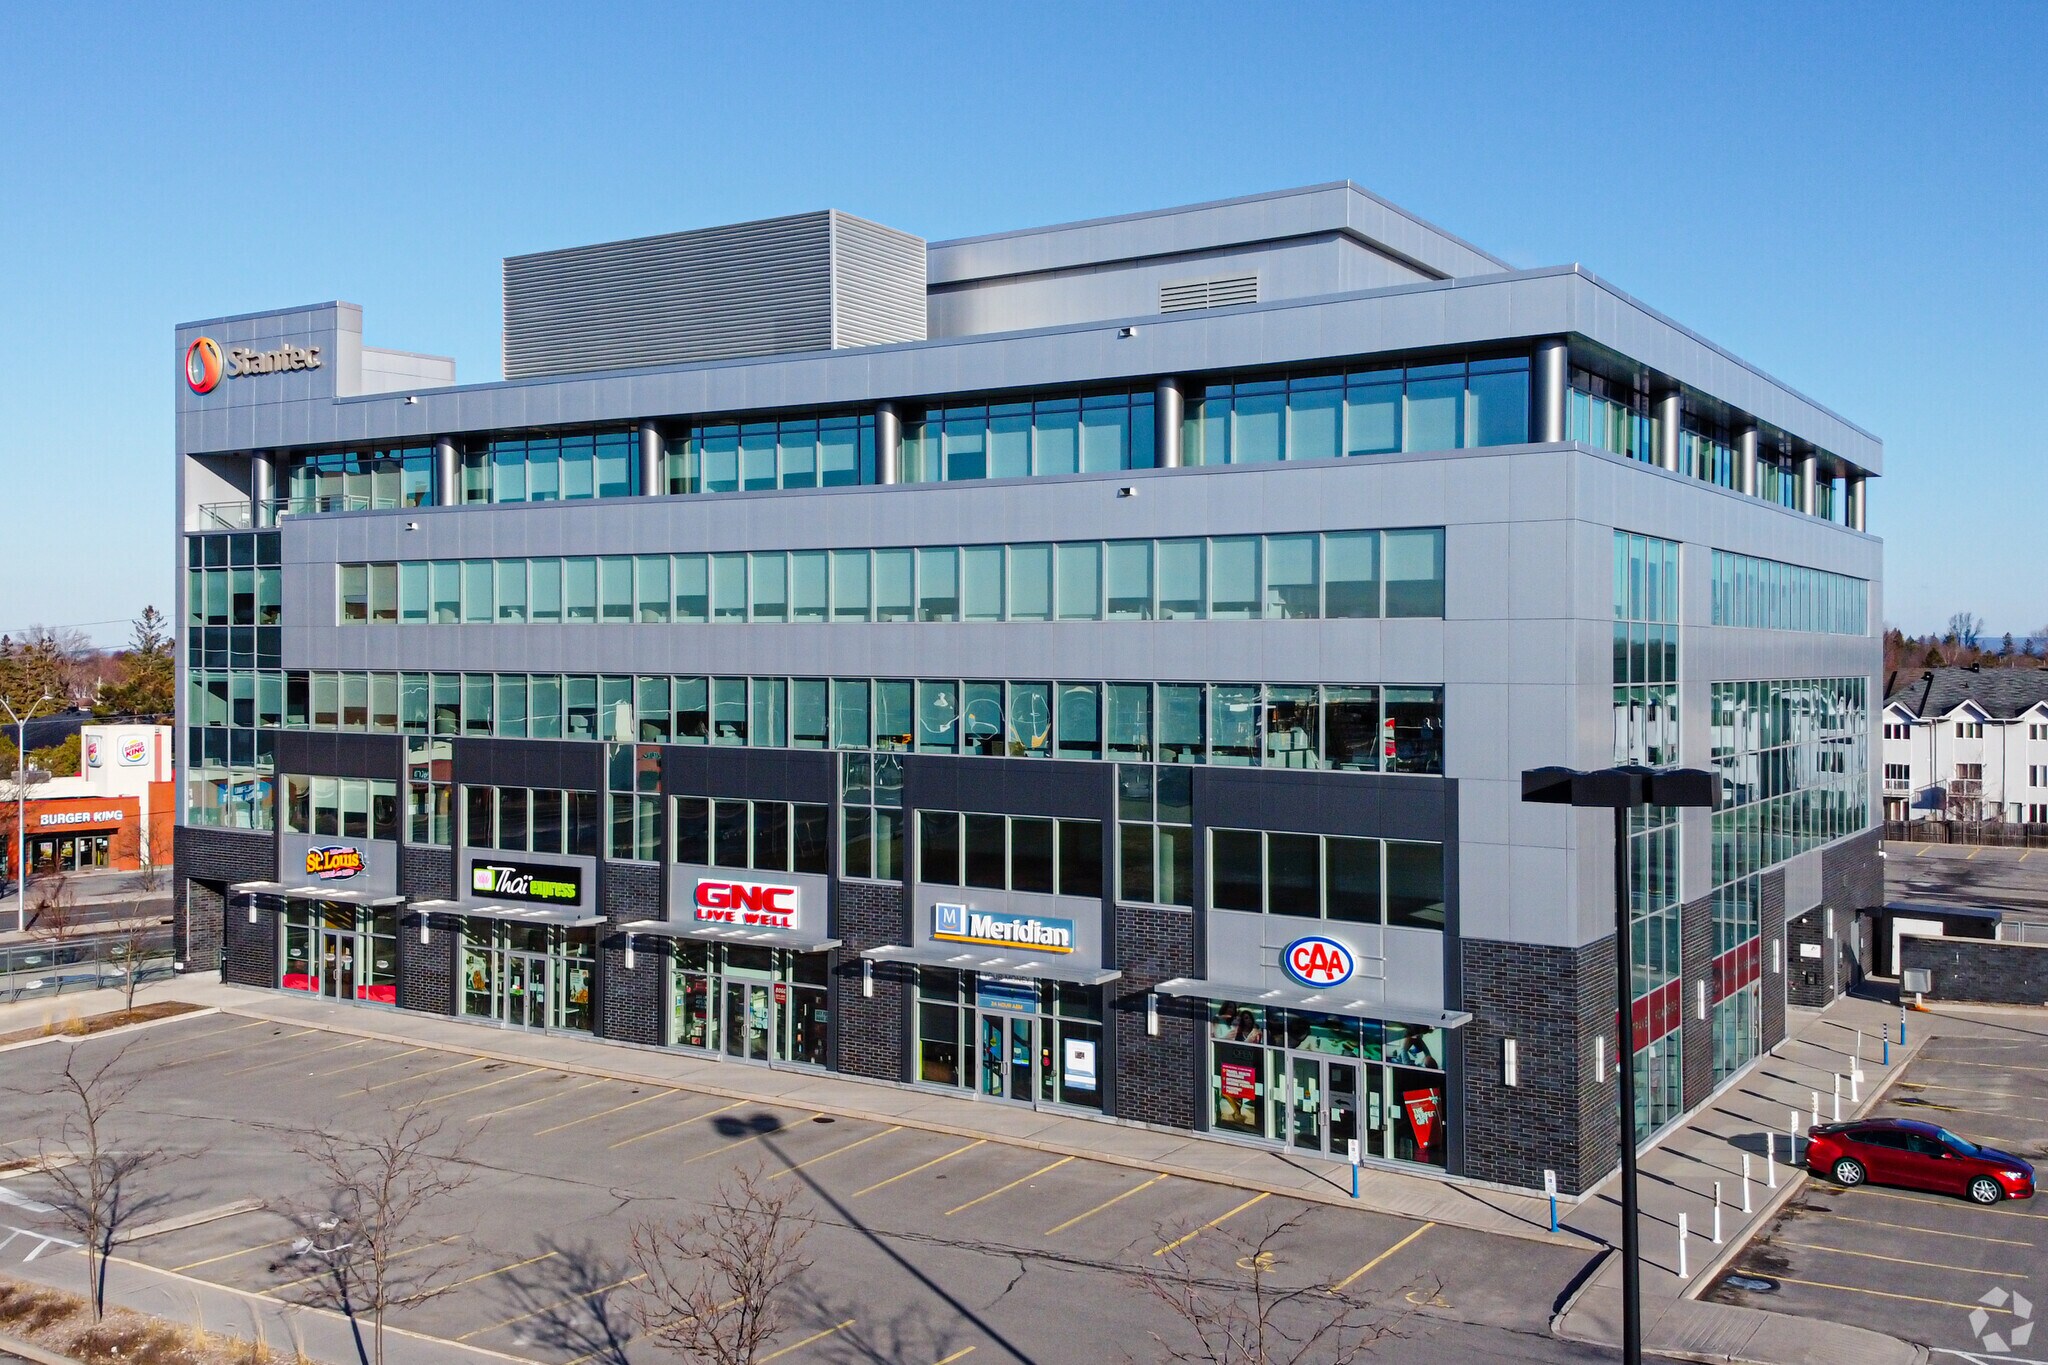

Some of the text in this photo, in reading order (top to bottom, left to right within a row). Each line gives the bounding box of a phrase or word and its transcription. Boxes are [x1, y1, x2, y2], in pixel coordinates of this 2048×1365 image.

[227, 343, 322, 378] Stantec
[126, 746, 145, 757] KING
[40, 810, 123, 825] BURGER KING
[306, 853, 323, 873] St.
[323, 851, 360, 870] Louis
[487, 865, 576, 898] Thaï express
[696, 882, 794, 914] GNC
[696, 909, 793, 928] LIVE WELL
[943, 908, 1069, 946] M Meridian
[1294, 943, 1345, 980] CAA
